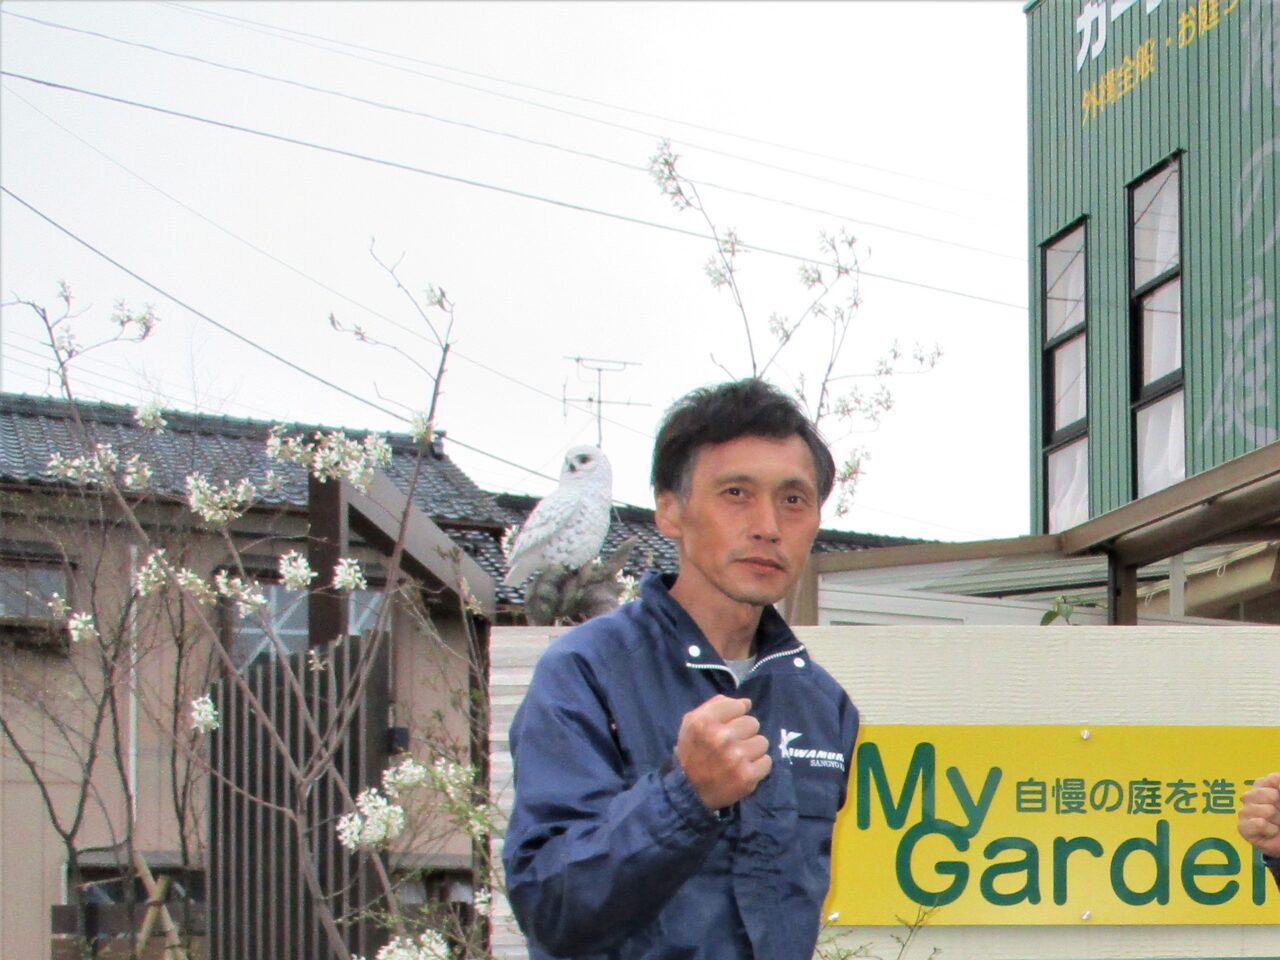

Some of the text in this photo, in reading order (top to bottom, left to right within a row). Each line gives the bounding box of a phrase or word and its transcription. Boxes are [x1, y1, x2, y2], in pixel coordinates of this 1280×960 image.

[1076, 0, 1163, 73] ガー
[778, 729, 845, 765] KAWAMUR
[857, 742, 1003, 839] My
[1016, 777, 1255, 815] 自慢の庭を造
